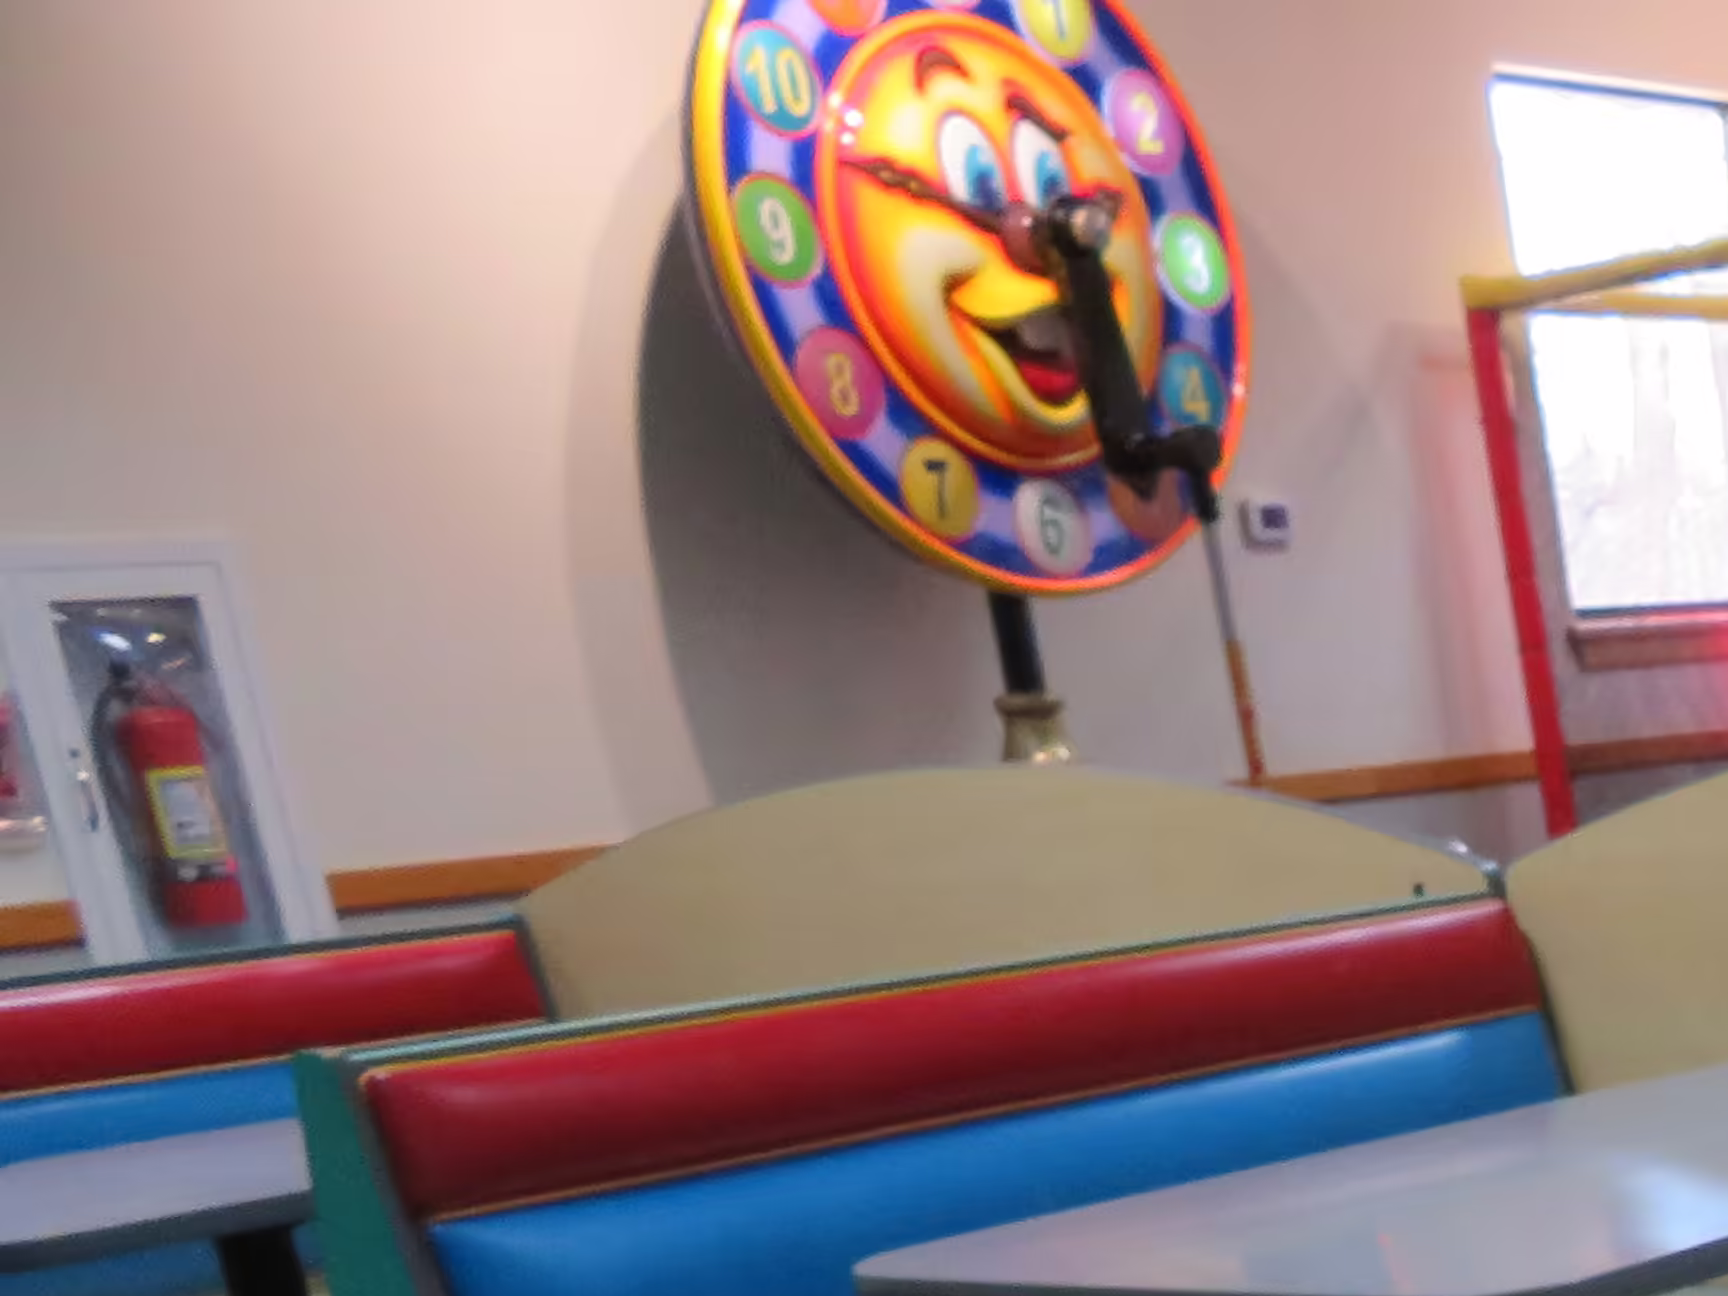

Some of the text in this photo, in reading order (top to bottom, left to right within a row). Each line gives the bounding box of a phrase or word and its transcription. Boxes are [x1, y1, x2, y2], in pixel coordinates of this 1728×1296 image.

[744, 46, 811, 118] 10
[1130, 91, 1165, 155] 2
[759, 196, 797, 267] 9
[1177, 232, 1211, 295] 3
[826, 352, 860, 418] 8
[1182, 365, 1211, 424] 4
[923, 459, 951, 522] 7
[1040, 493, 1066, 559] 6
